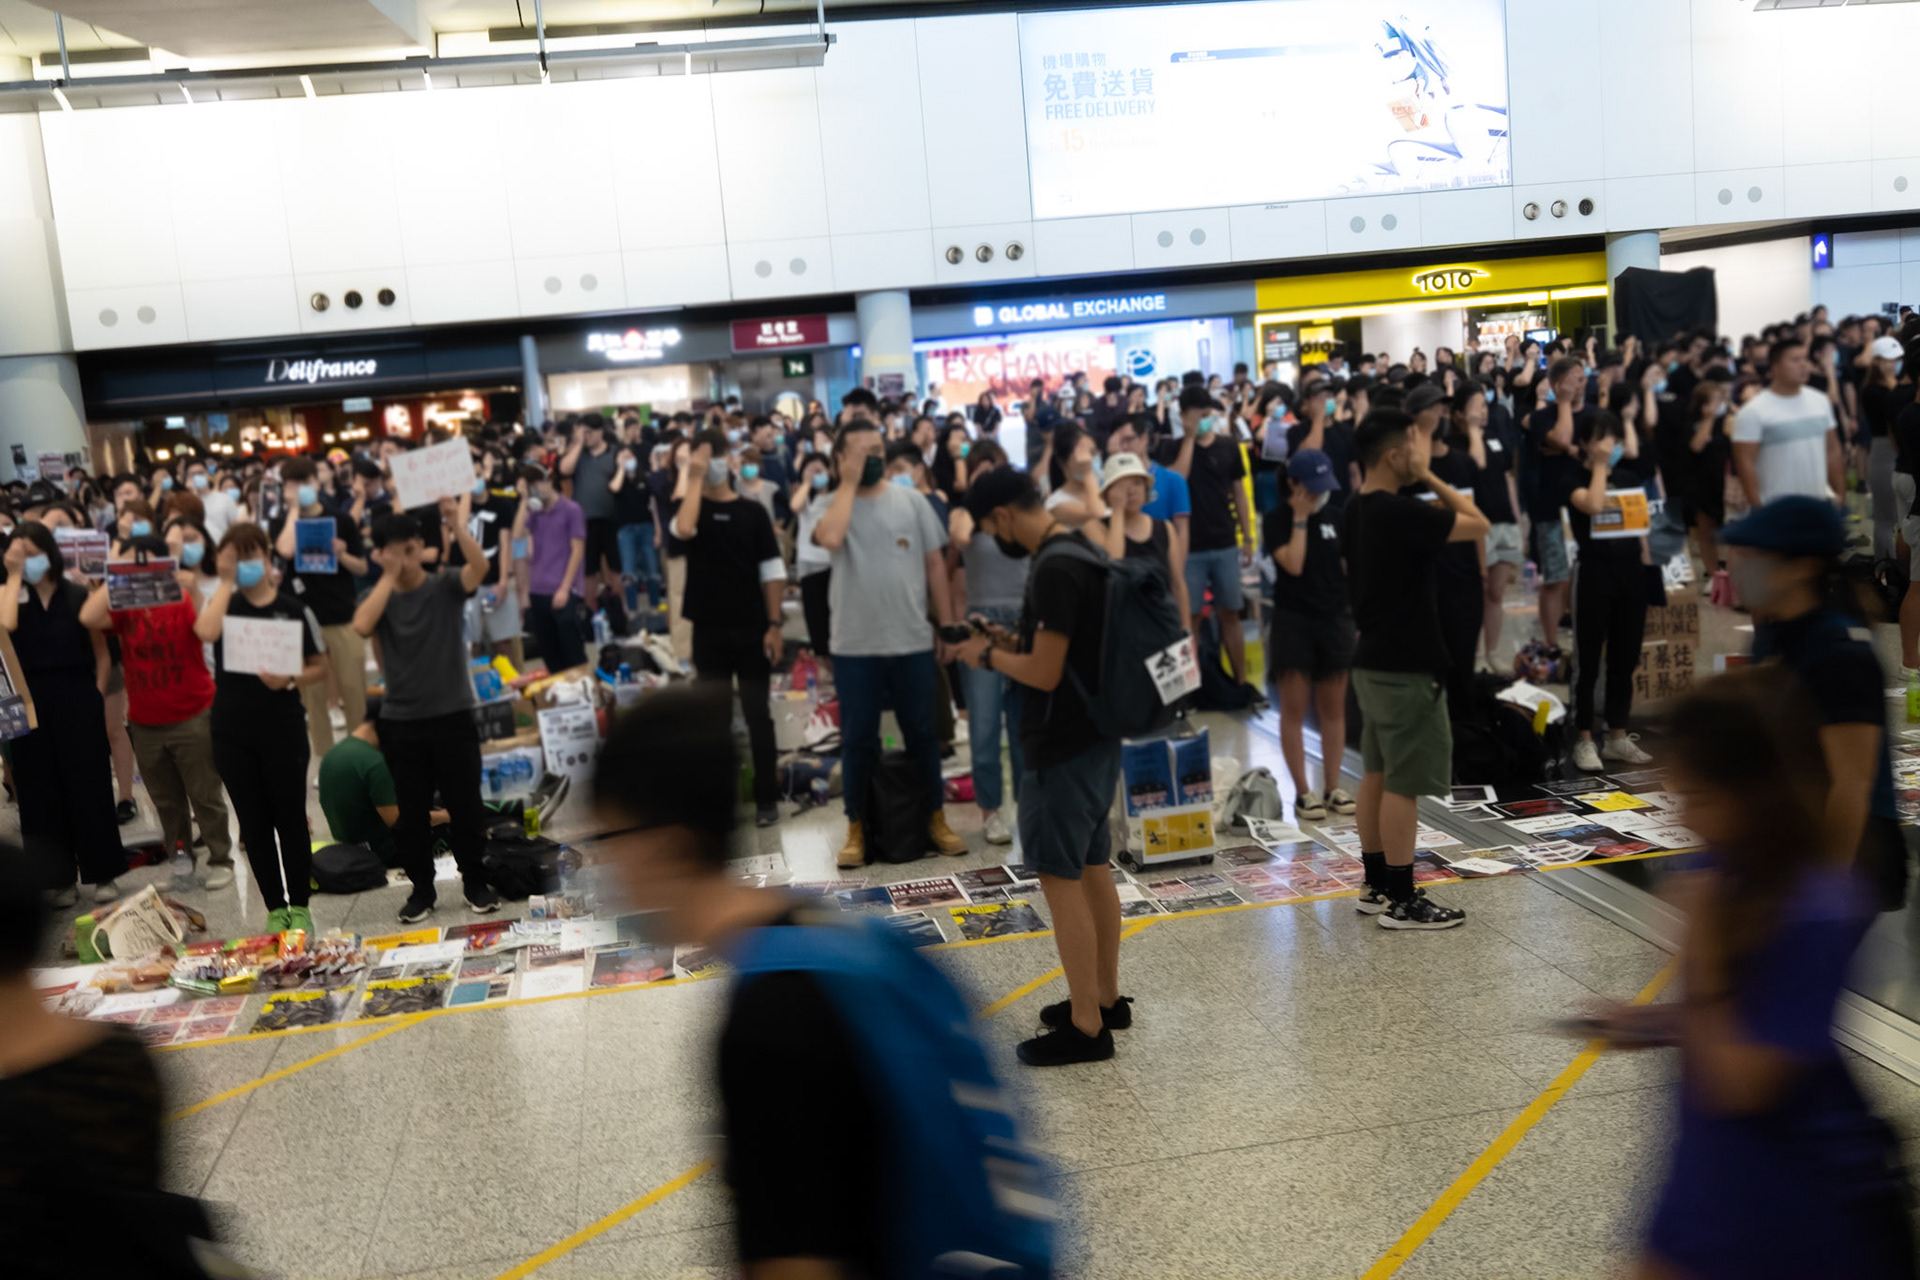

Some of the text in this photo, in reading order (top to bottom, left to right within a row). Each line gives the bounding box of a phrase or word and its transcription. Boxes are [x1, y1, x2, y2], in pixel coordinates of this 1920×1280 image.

[1042, 52, 1107, 70] 機場購物
[1043, 68, 1154, 102] 免費送貨
[1045, 99, 1156, 120] FREE DELIVERY
[1060, 128, 1086, 152] 15
[1415, 269, 1479, 292] TOTO
[998, 295, 1166, 324] GLOBAL EXCHANGE
[265, 357, 378, 384] Délifrance
[941, 345, 1102, 383] EXCHANGE
